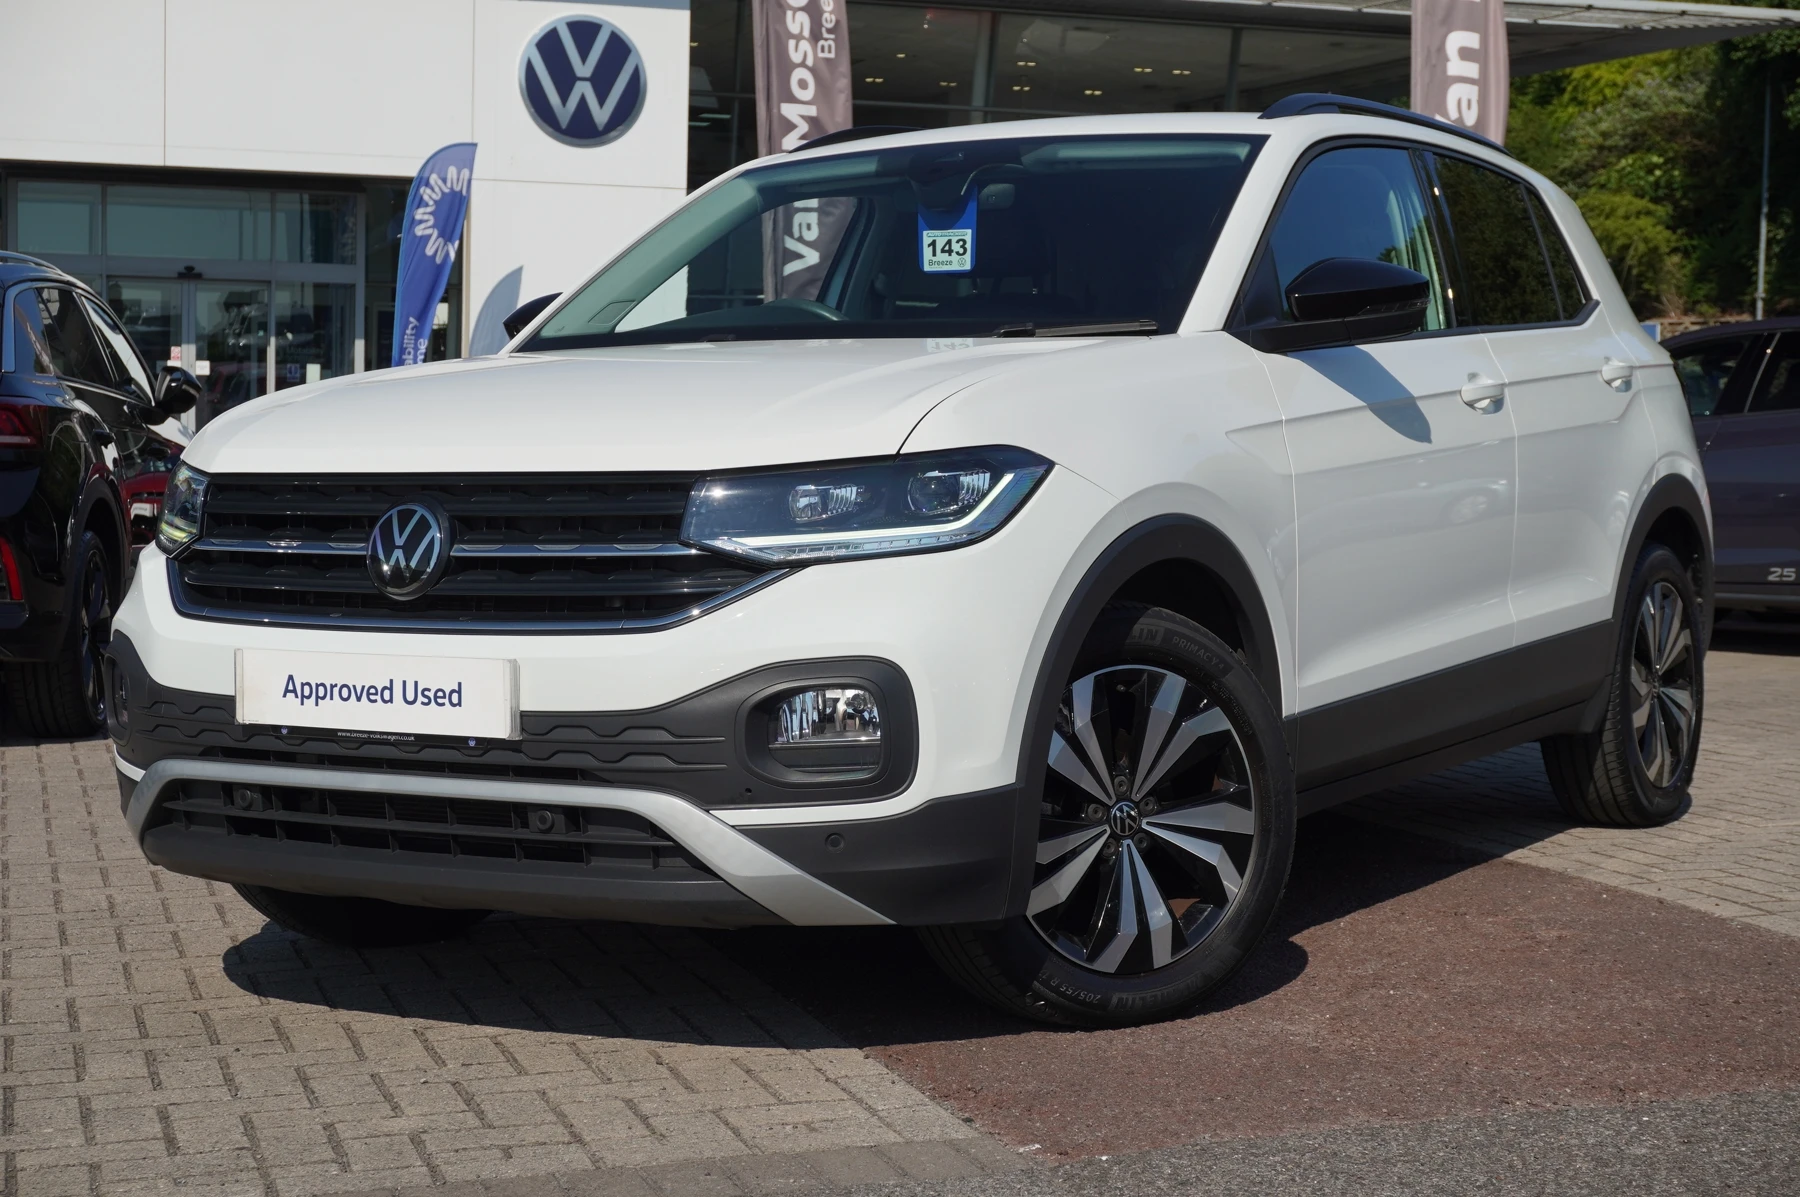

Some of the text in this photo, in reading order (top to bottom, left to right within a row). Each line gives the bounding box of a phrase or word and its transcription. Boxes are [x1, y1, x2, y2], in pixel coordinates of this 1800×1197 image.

[520, 17, 645, 144] VW
[1434, 30, 1481, 127] an
[927, 238, 968, 257] 143
[928, 259, 953, 267] Breeze
[1768, 567, 1796, 581] 25
[1172, 636, 1220, 667] PRIMACY
[282, 674, 463, 708] Approved Used
[1059, 983, 1102, 1004] 205/55
